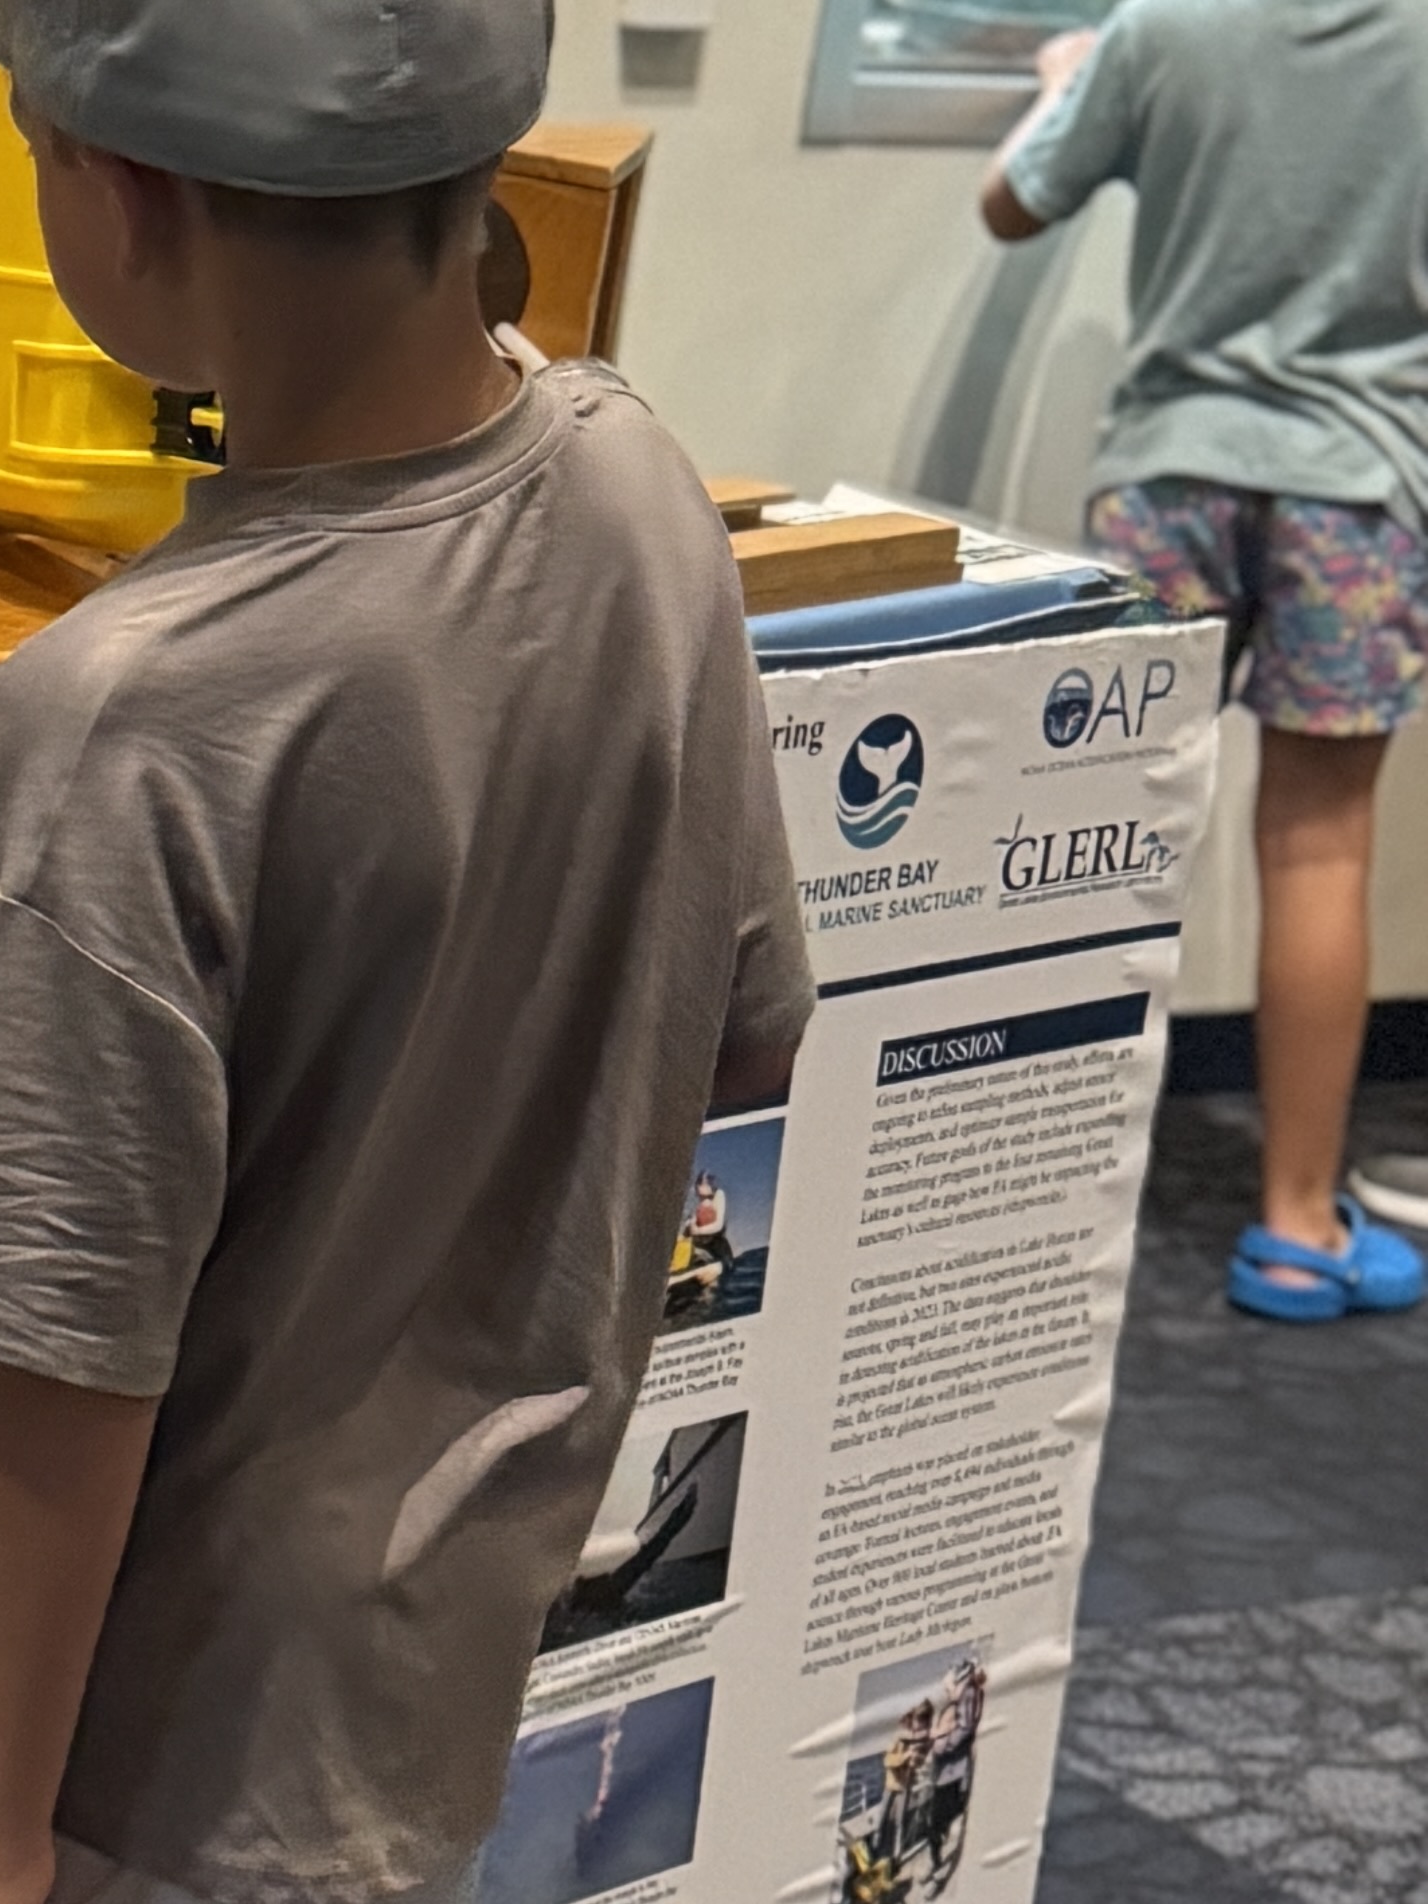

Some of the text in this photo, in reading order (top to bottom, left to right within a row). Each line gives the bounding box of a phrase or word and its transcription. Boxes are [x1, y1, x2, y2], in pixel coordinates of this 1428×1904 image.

[896, 858, 940, 889] BAY
[1002, 820, 1146, 892] GLERL
[818, 900, 884, 931] MARINE
[887, 884, 988, 920] SANCTUARY
[881, 1026, 1008, 1078] DISCUSSION
